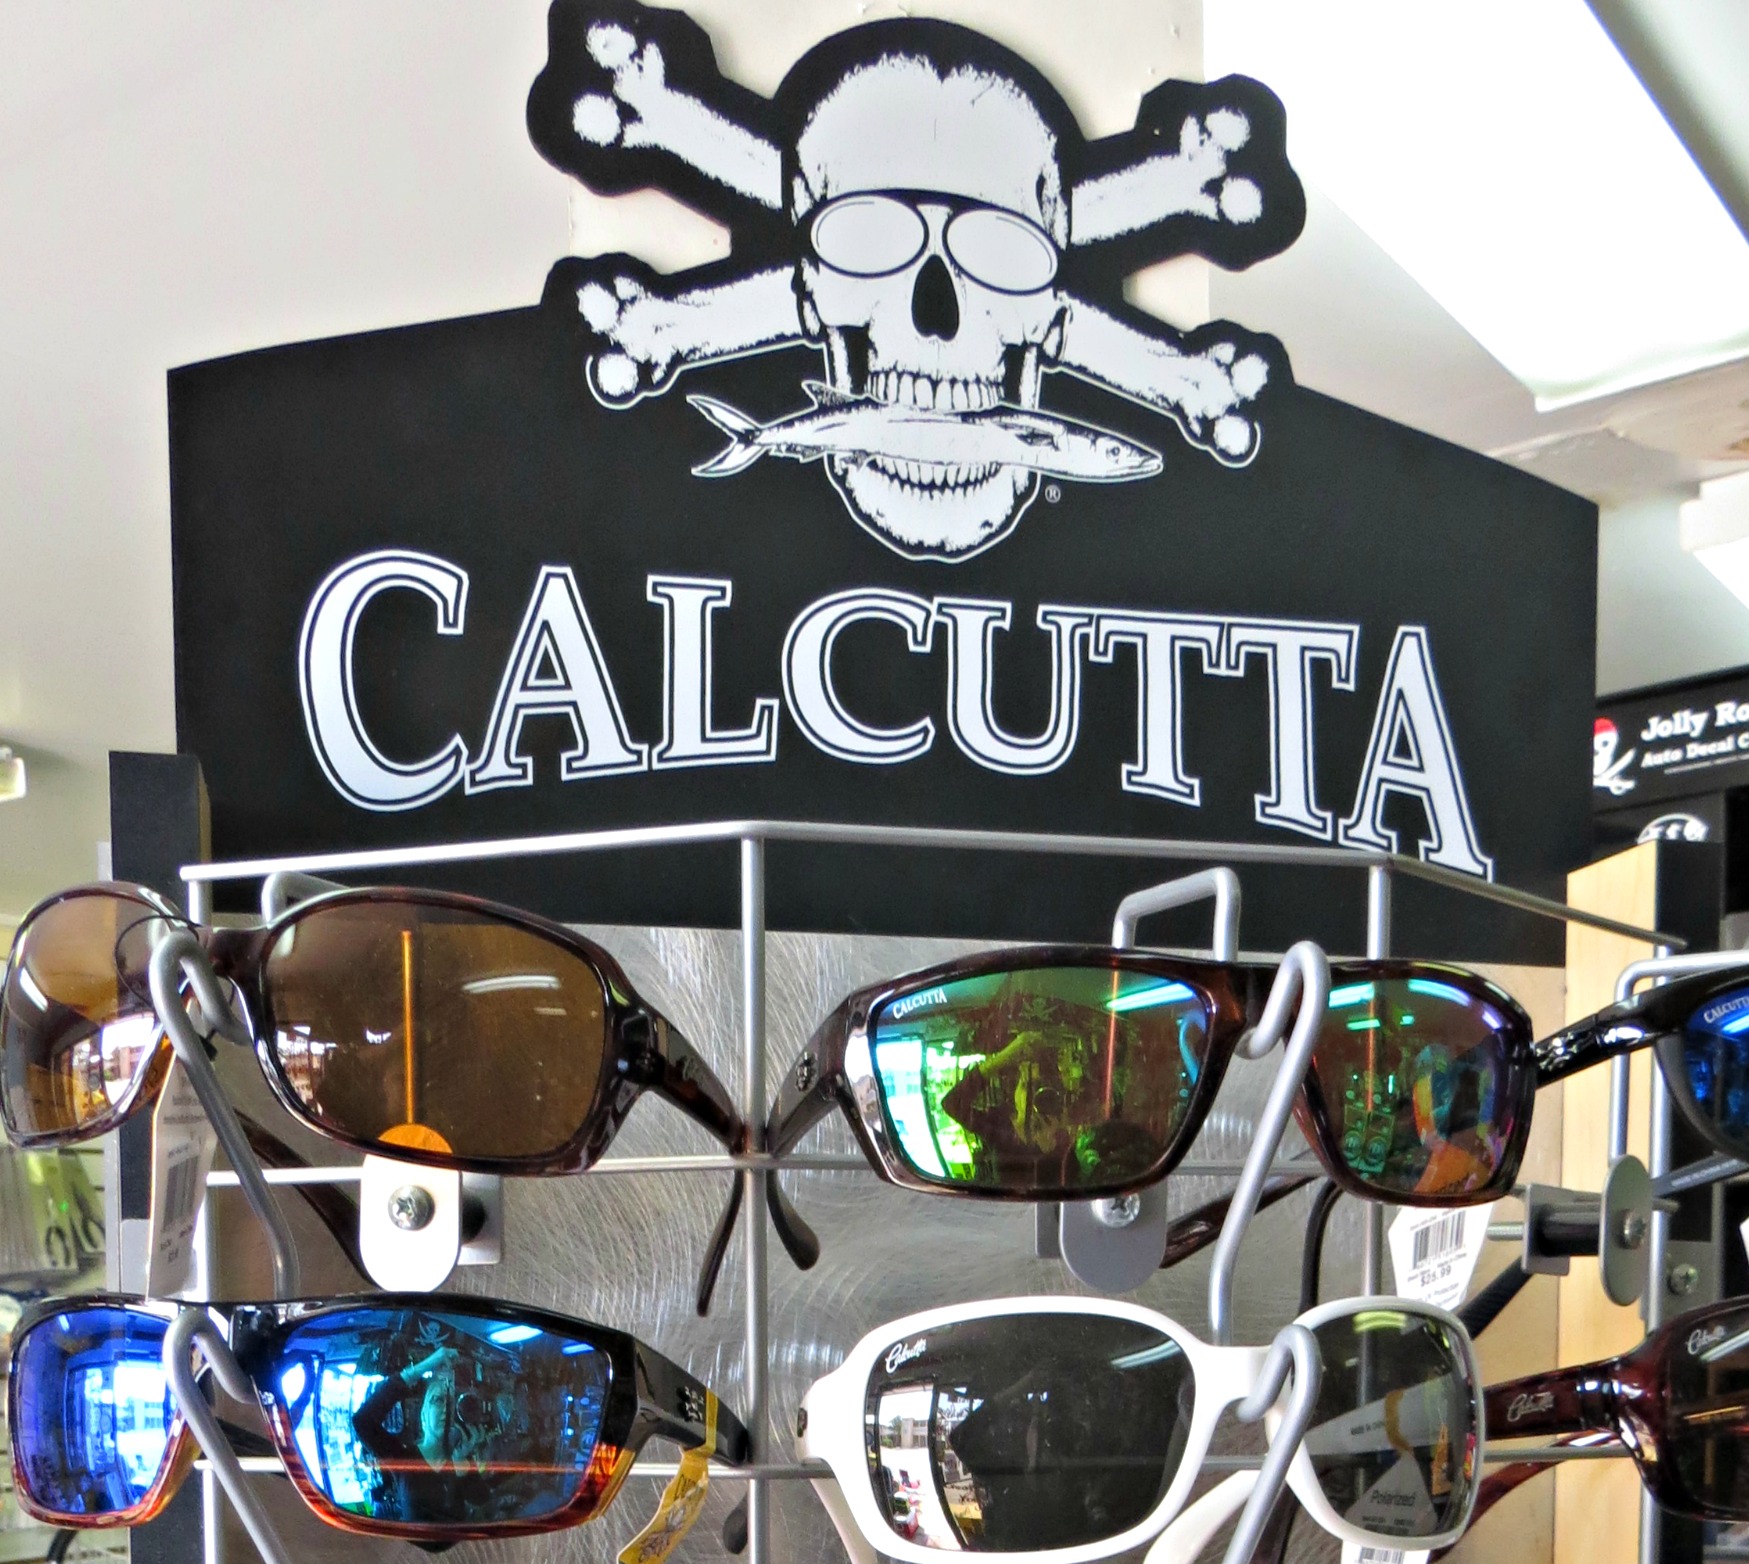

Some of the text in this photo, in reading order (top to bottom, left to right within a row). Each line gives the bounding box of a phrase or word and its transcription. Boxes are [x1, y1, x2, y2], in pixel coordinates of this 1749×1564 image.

[299, 549, 1494, 878] CALCUTTA
[1641, 710, 1709, 742] Jolly
[1641, 748, 1684, 768] Auto
[1686, 735, 1735, 760] Decal
[892, 987, 948, 1020] CALCUTTA
[885, 1338, 928, 1374] Calcutta
